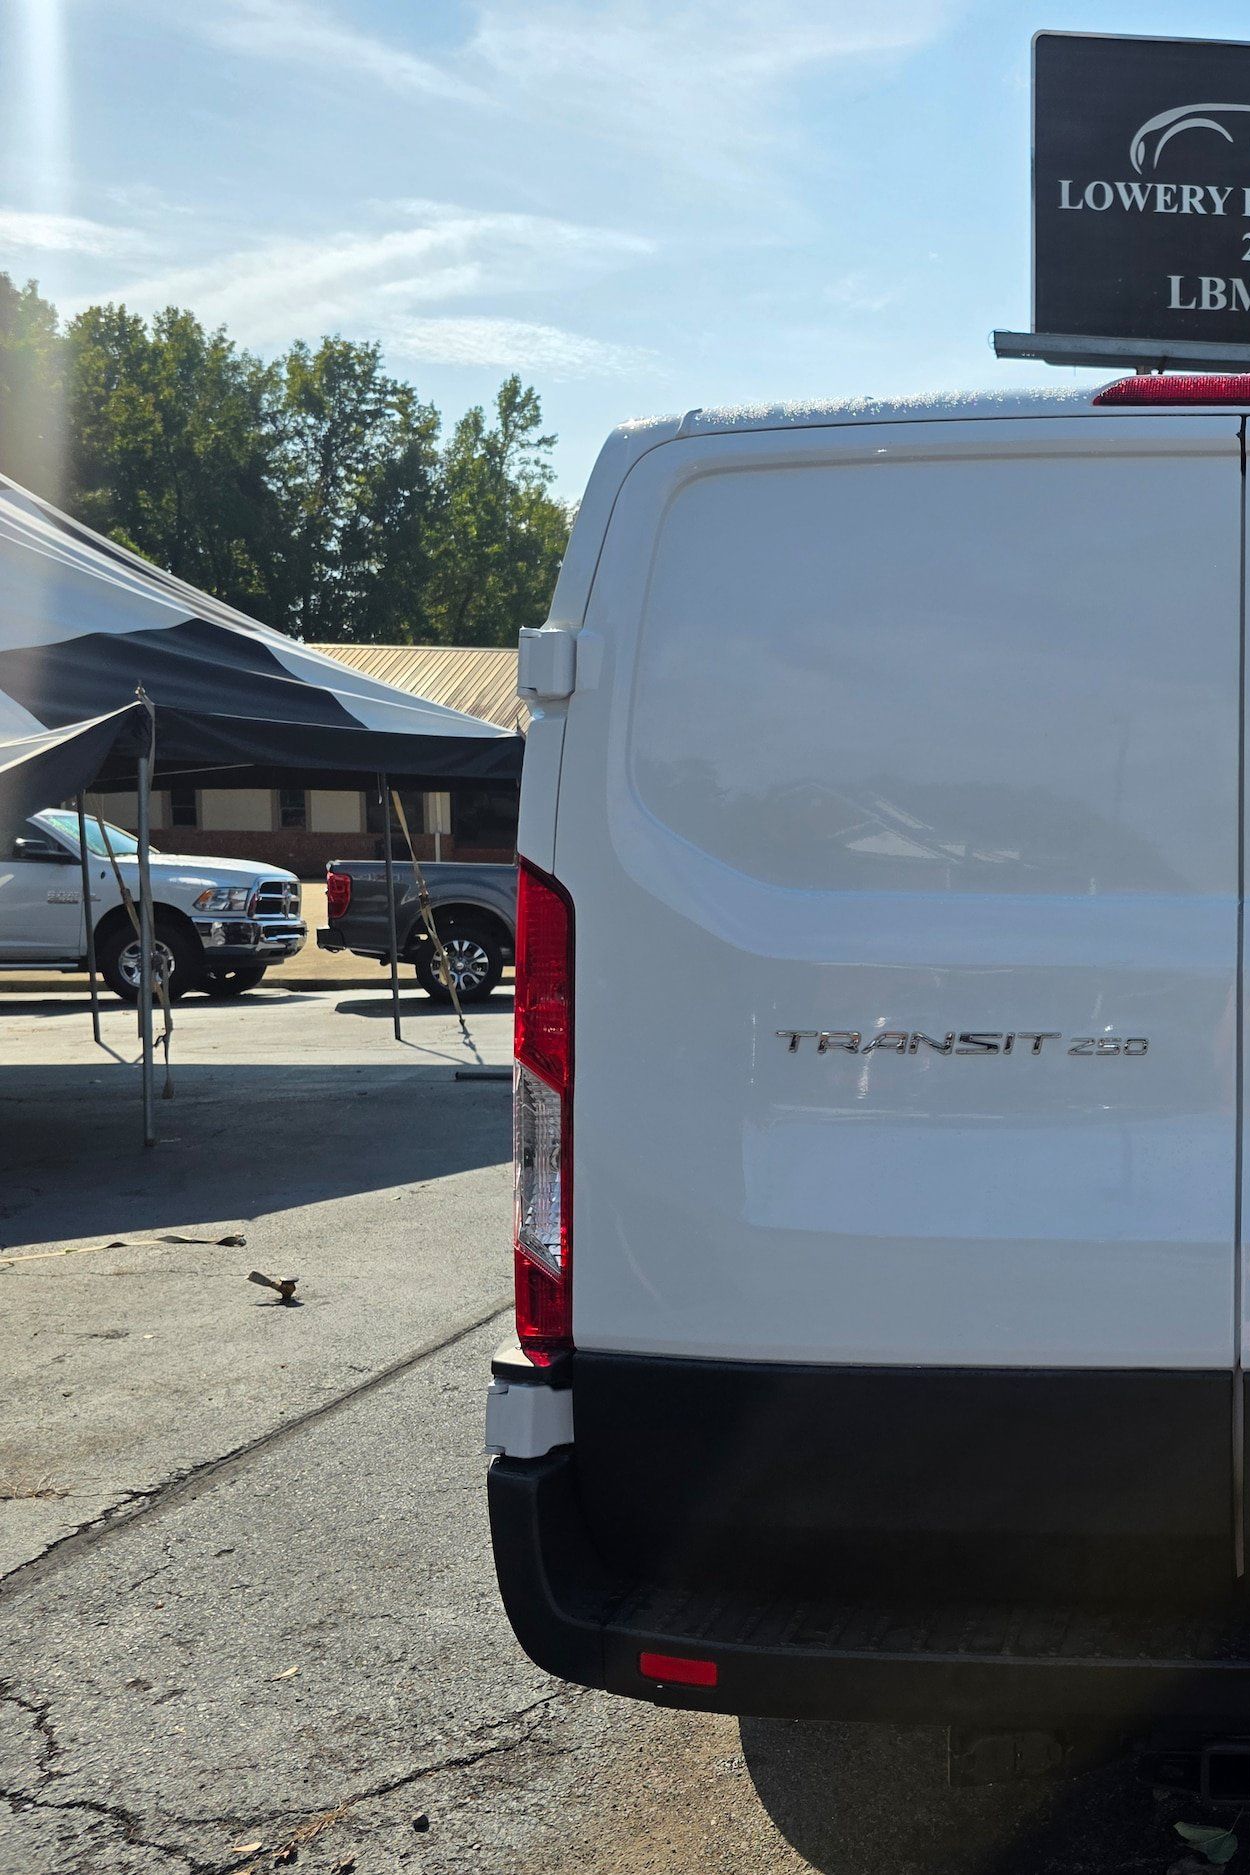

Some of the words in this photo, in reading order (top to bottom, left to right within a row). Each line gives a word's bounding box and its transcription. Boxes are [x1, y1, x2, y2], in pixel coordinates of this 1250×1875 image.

[1058, 179, 1233, 216] LOWERY
[776, 1031, 1062, 1055] TRANSIT
[1067, 1037, 1150, 1056] 250
